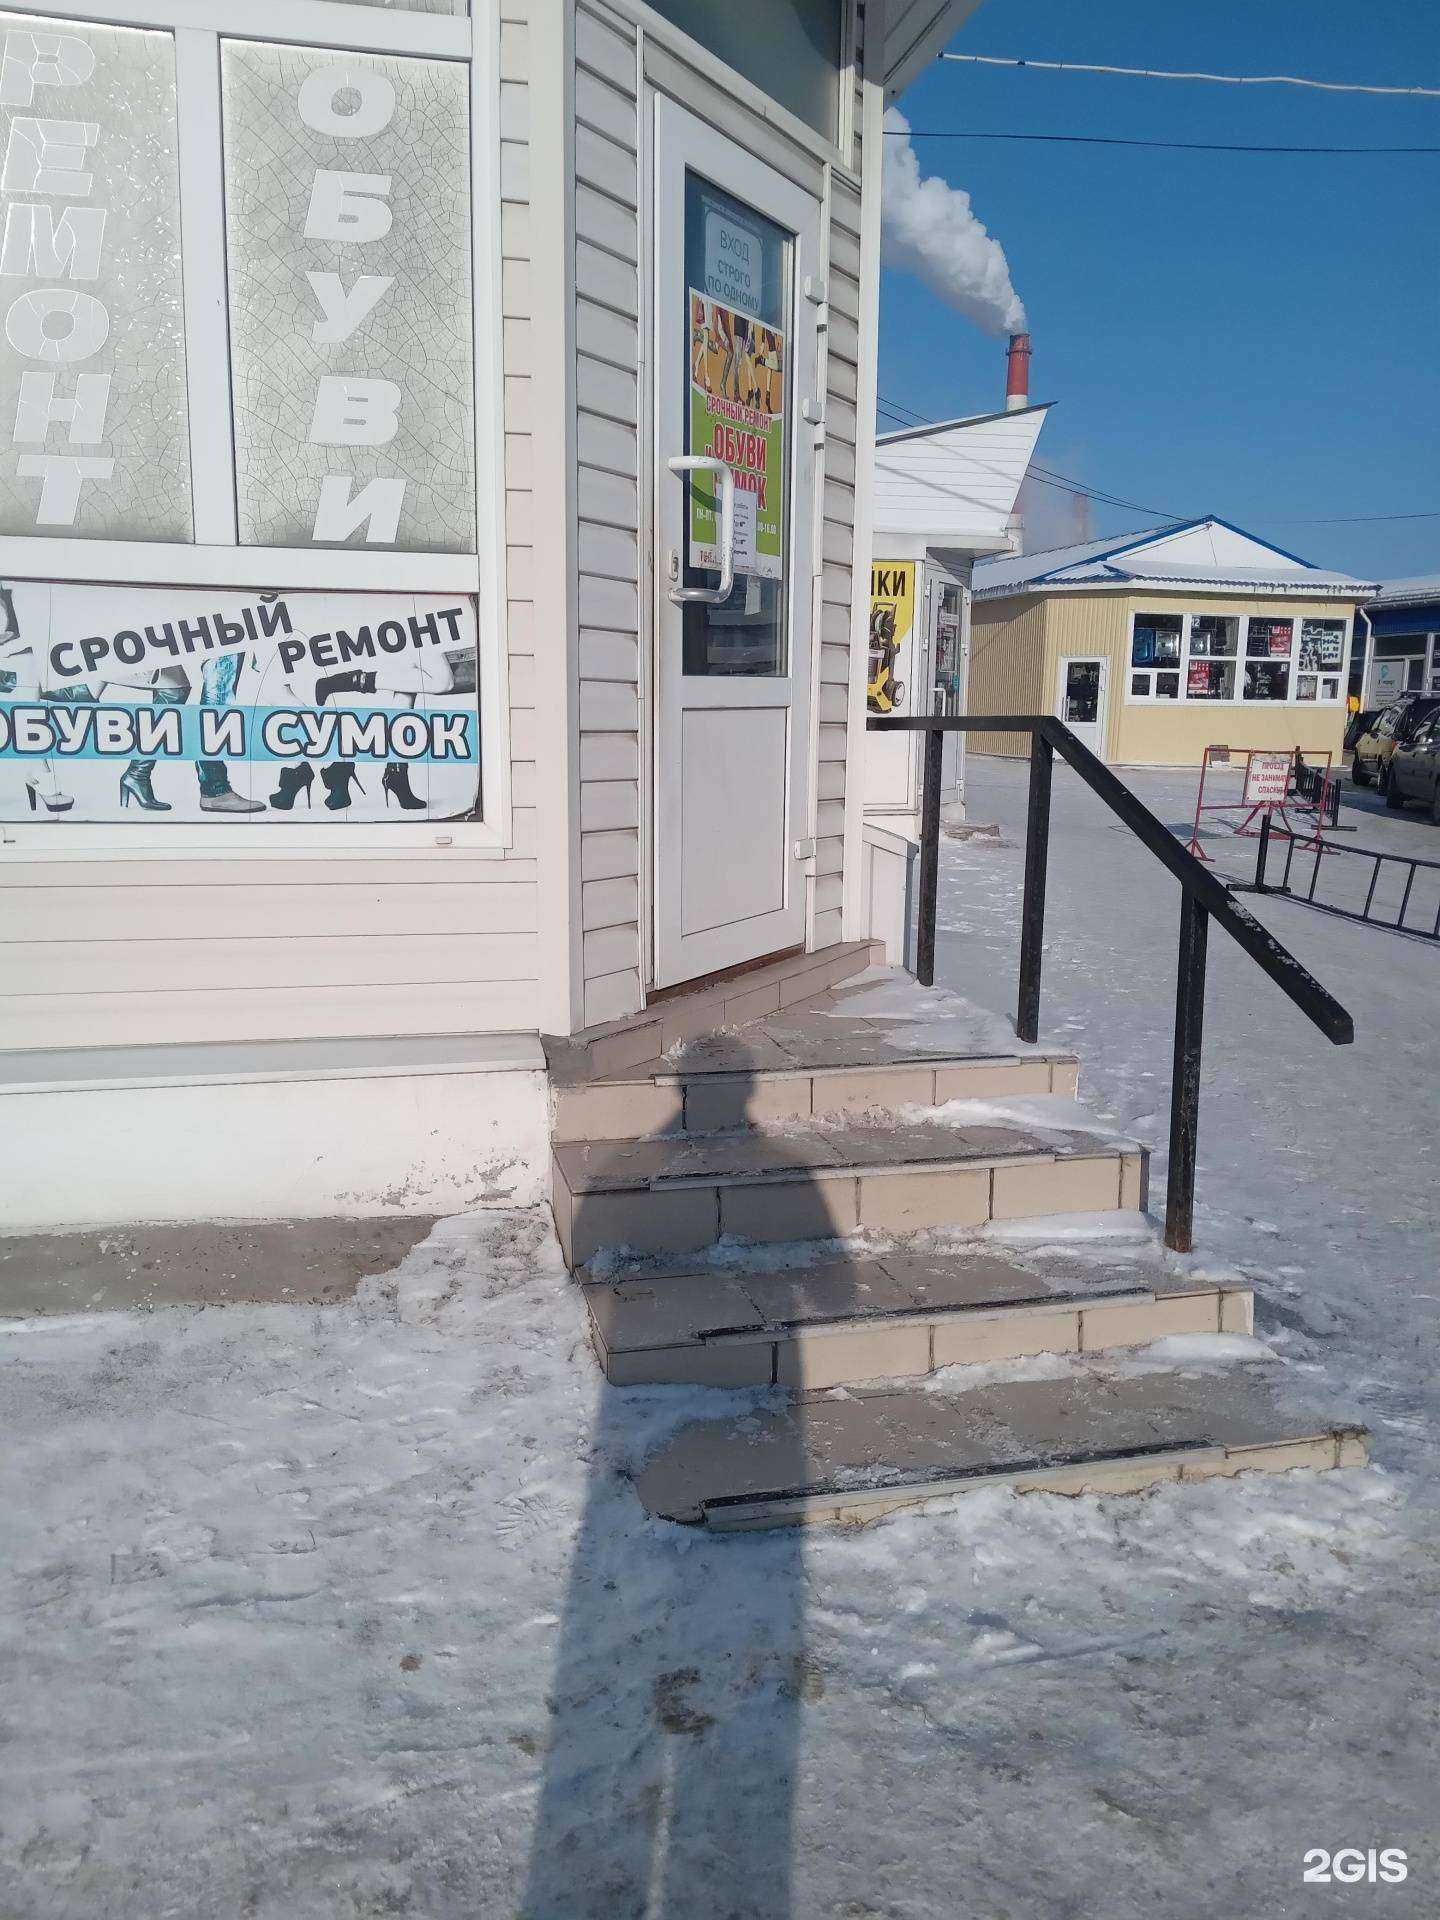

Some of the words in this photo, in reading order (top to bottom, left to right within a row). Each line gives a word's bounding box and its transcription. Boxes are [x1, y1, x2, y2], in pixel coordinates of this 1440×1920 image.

[720, 230, 750, 264] ВХОД
[0, 30, 116, 526] РЕМОНТ
[298, 63, 407, 543] ОБУВИ
[708, 275, 722, 293] ПО
[714, 421, 767, 473] ОБУВИ
[871, 567, 906, 597] КИ
[50, 591, 293, 677] СРОЧНЫЙ
[278, 608, 463, 674] РЕМОНТ
[200, 709, 246, 757] И
[262, 709, 471, 760] СУМОК
